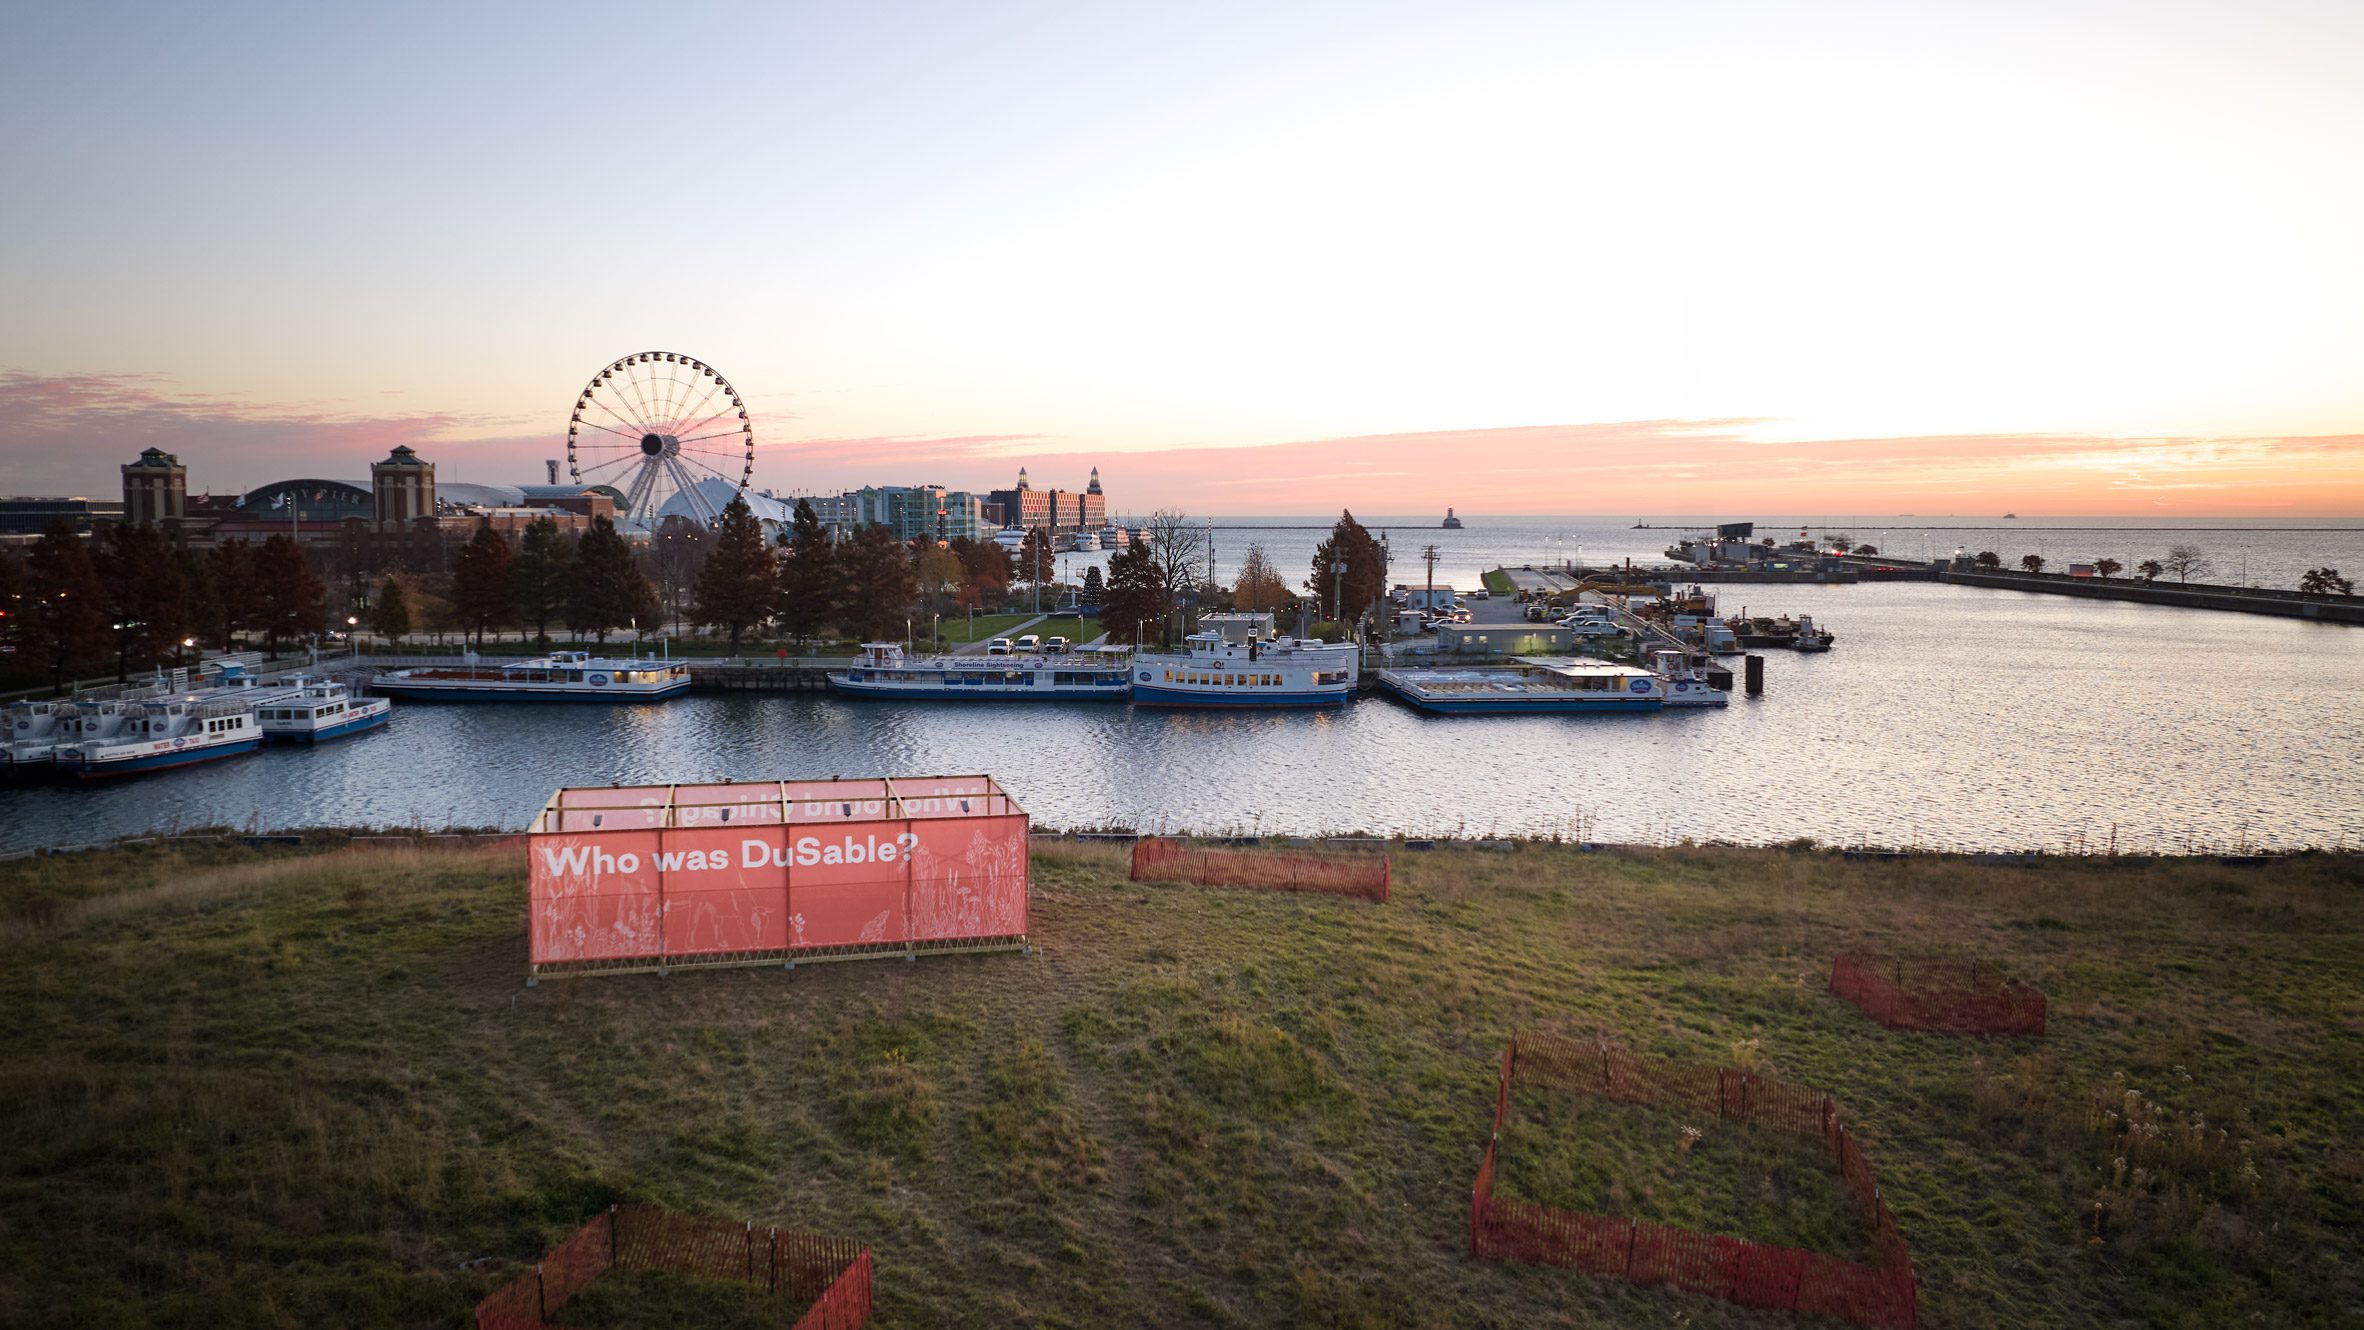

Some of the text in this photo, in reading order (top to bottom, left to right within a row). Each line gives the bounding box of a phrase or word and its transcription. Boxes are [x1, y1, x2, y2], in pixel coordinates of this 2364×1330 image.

[543, 832, 919, 877] Who was DuSable?
